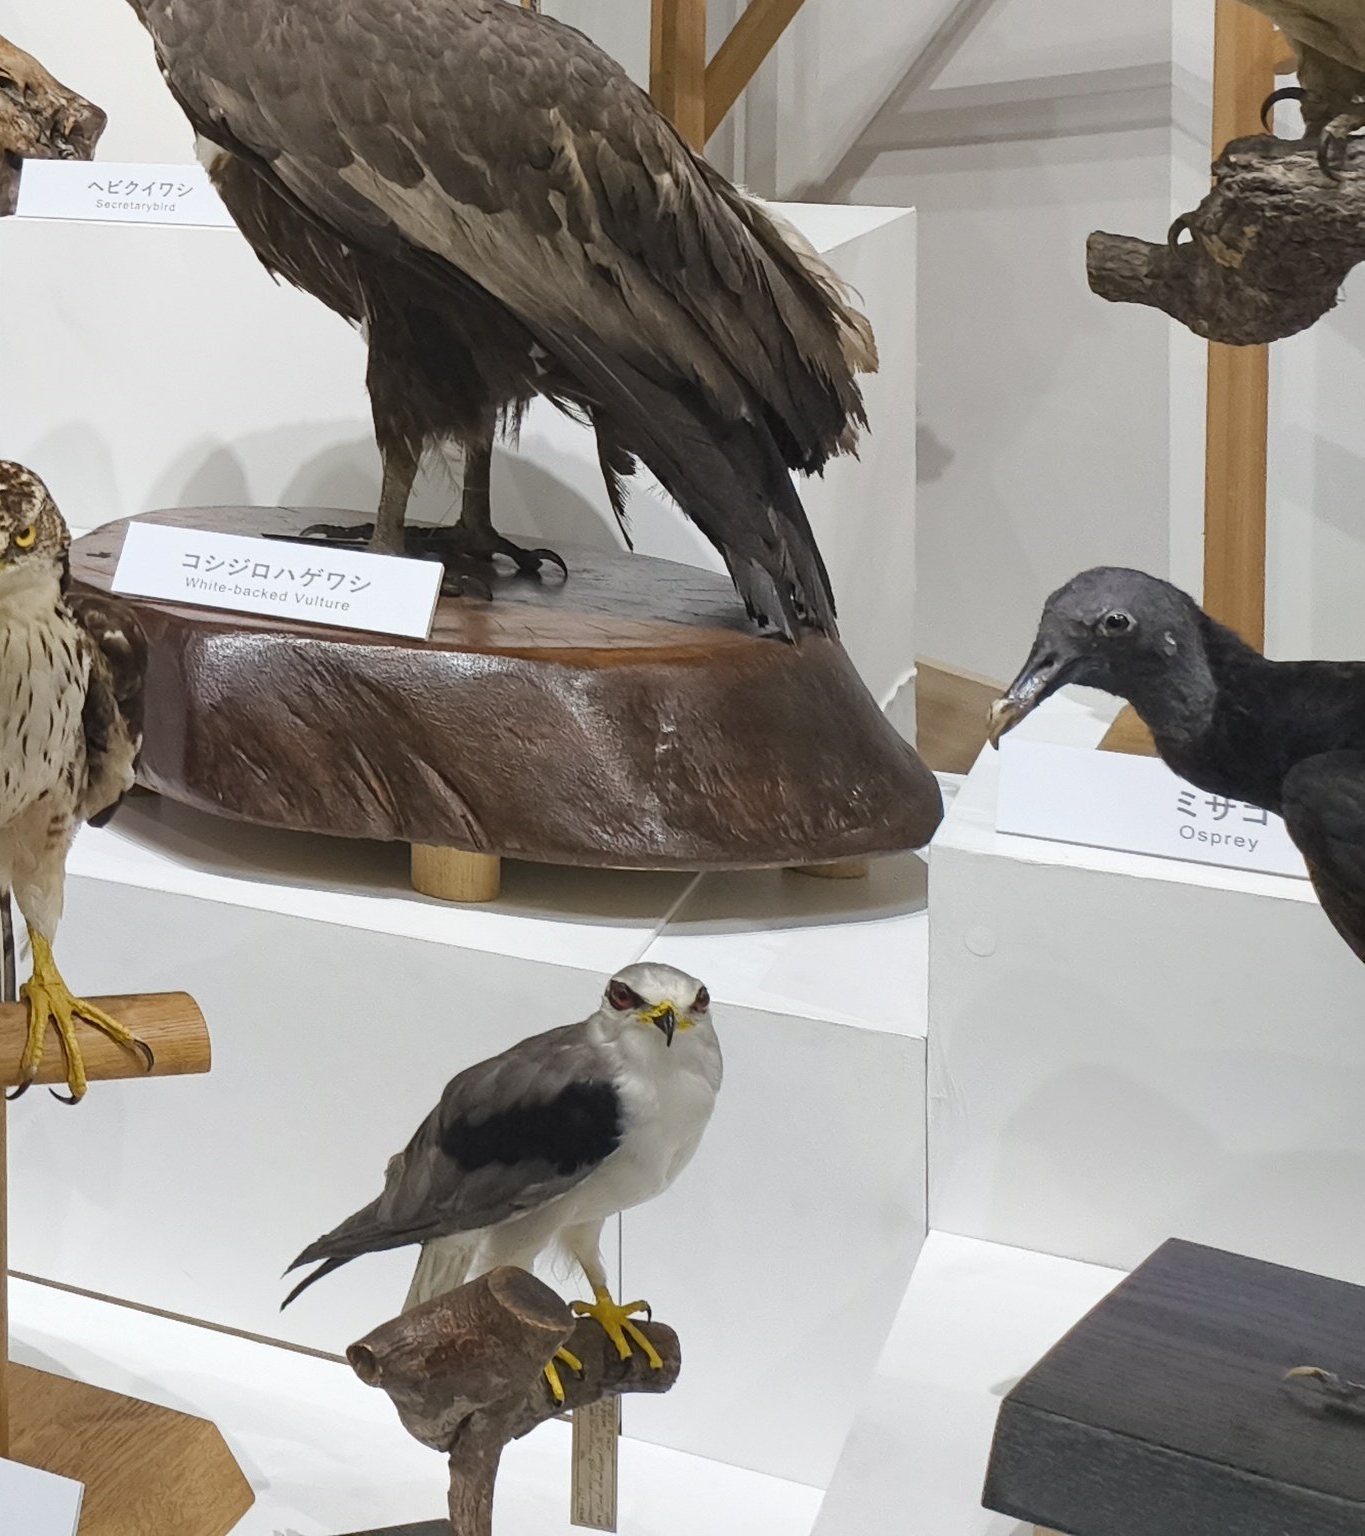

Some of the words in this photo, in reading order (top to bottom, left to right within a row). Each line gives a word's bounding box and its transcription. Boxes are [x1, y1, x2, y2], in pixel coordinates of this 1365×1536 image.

[87, 179, 194, 198] ヘビクイワシ
[96, 199, 176, 212] Secretarybird
[181, 552, 372, 593] コシジロハゲワシ
[184, 576, 288, 602] White-backed
[295, 592, 351, 611] Vulture
[1179, 825, 1259, 852] Osprey
